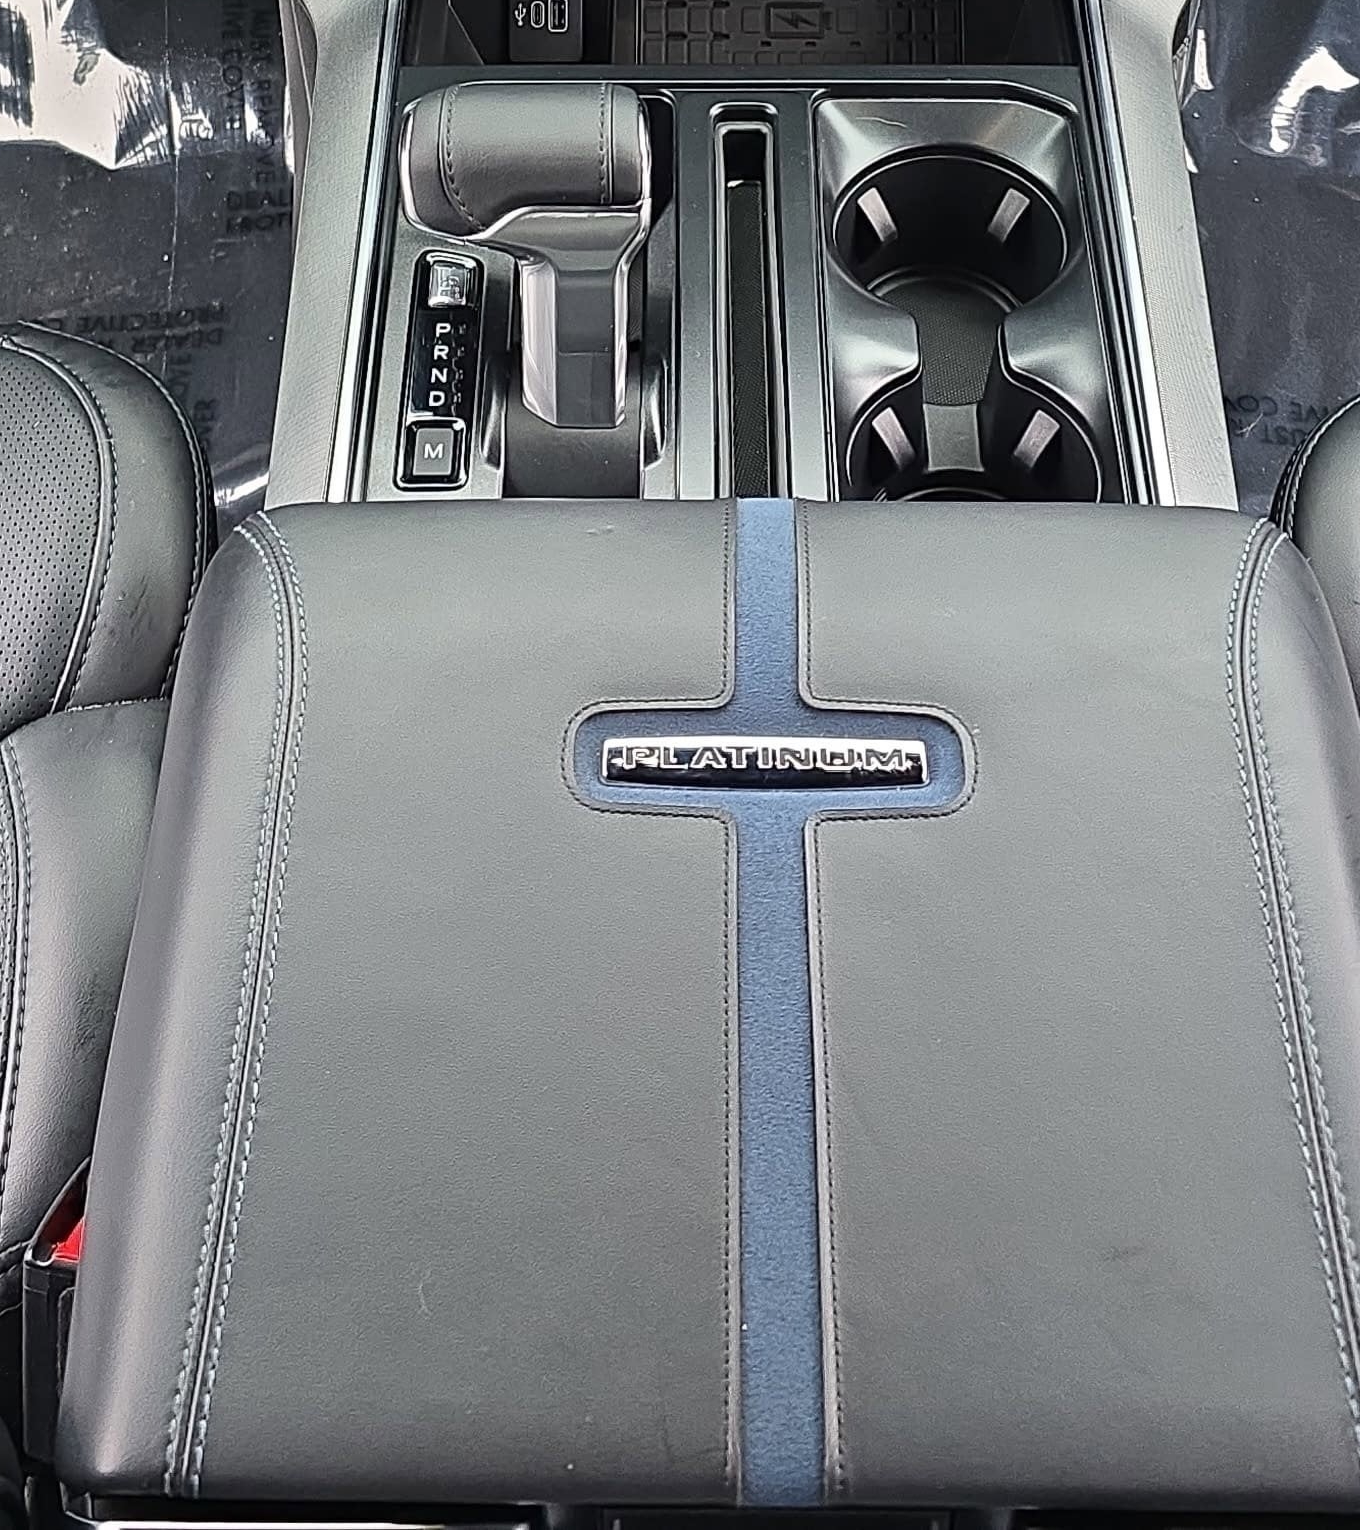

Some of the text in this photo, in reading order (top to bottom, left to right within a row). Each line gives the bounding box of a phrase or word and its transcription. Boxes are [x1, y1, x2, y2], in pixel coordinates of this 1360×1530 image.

[435, 322, 452, 337] P
[433, 345, 449, 360] R
[430, 368, 448, 384] N
[428, 391, 446, 407] D
[423, 443, 444, 459] M
[621, 744, 912, 770] PLATINUM
